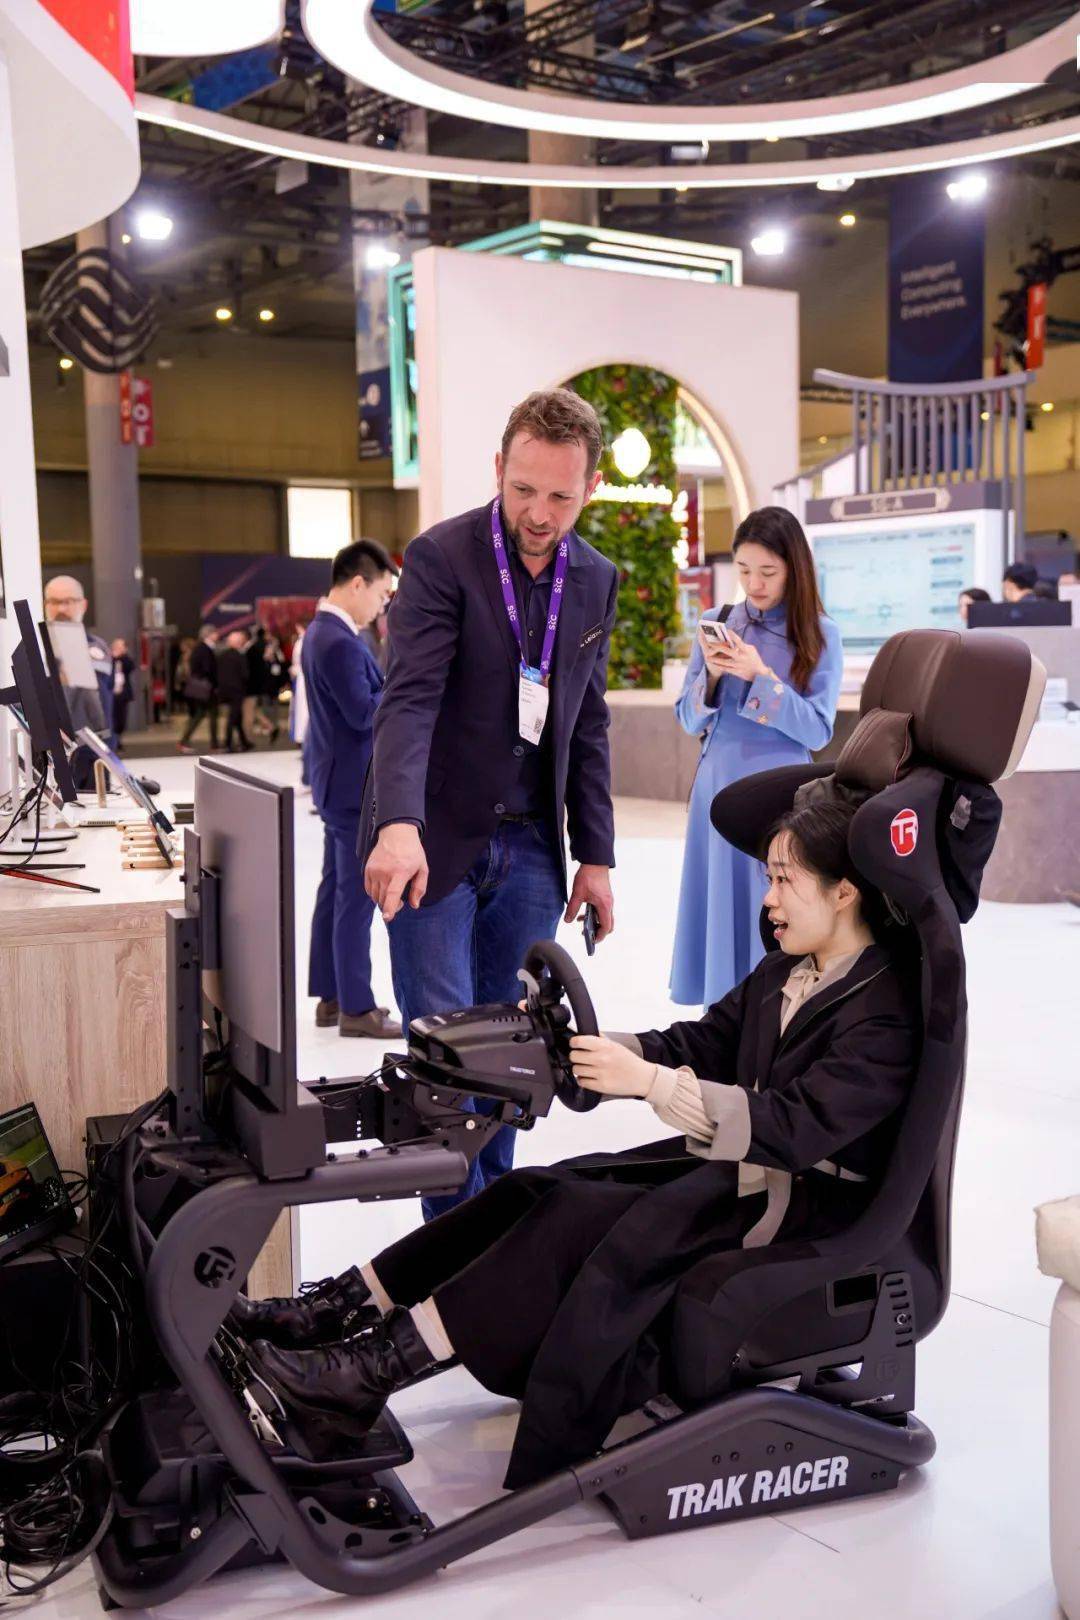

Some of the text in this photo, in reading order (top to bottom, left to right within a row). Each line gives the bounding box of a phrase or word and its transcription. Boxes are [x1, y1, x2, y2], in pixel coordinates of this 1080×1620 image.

[493, 533, 502, 549] stc
[559, 542, 568, 558] stc
[500, 568, 510, 585] stc
[554, 577, 563, 593] stc
[507, 605, 517, 621] stc
[548, 614, 558, 630] stc
[667, 1455, 850, 1521] TRAK RACER
